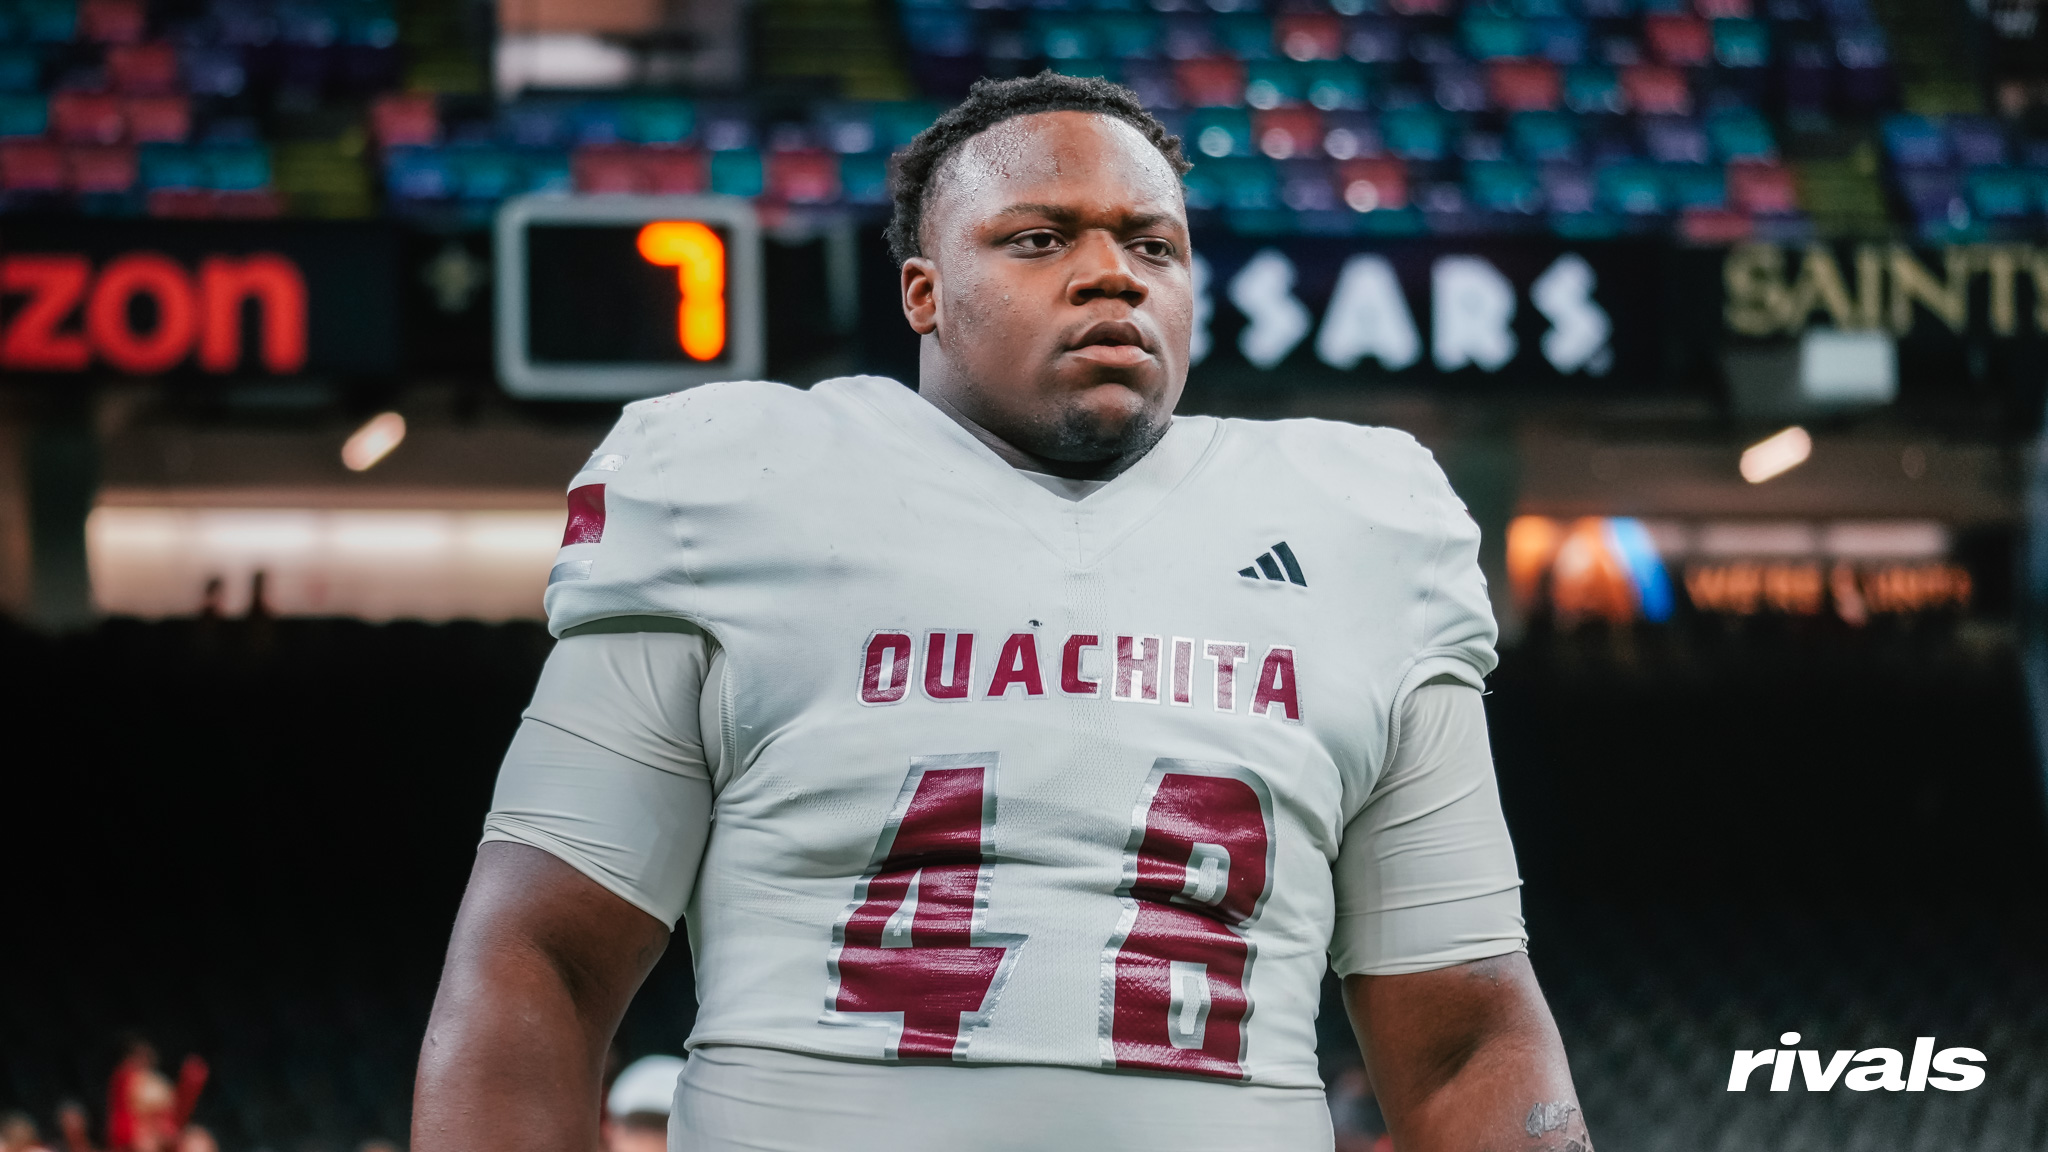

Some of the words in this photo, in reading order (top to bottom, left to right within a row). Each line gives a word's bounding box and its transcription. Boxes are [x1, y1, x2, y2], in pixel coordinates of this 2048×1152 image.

[636, 220, 726, 362] 7
[858, 628, 1303, 725] OUACHITA
[818, 750, 1277, 1082] 48
